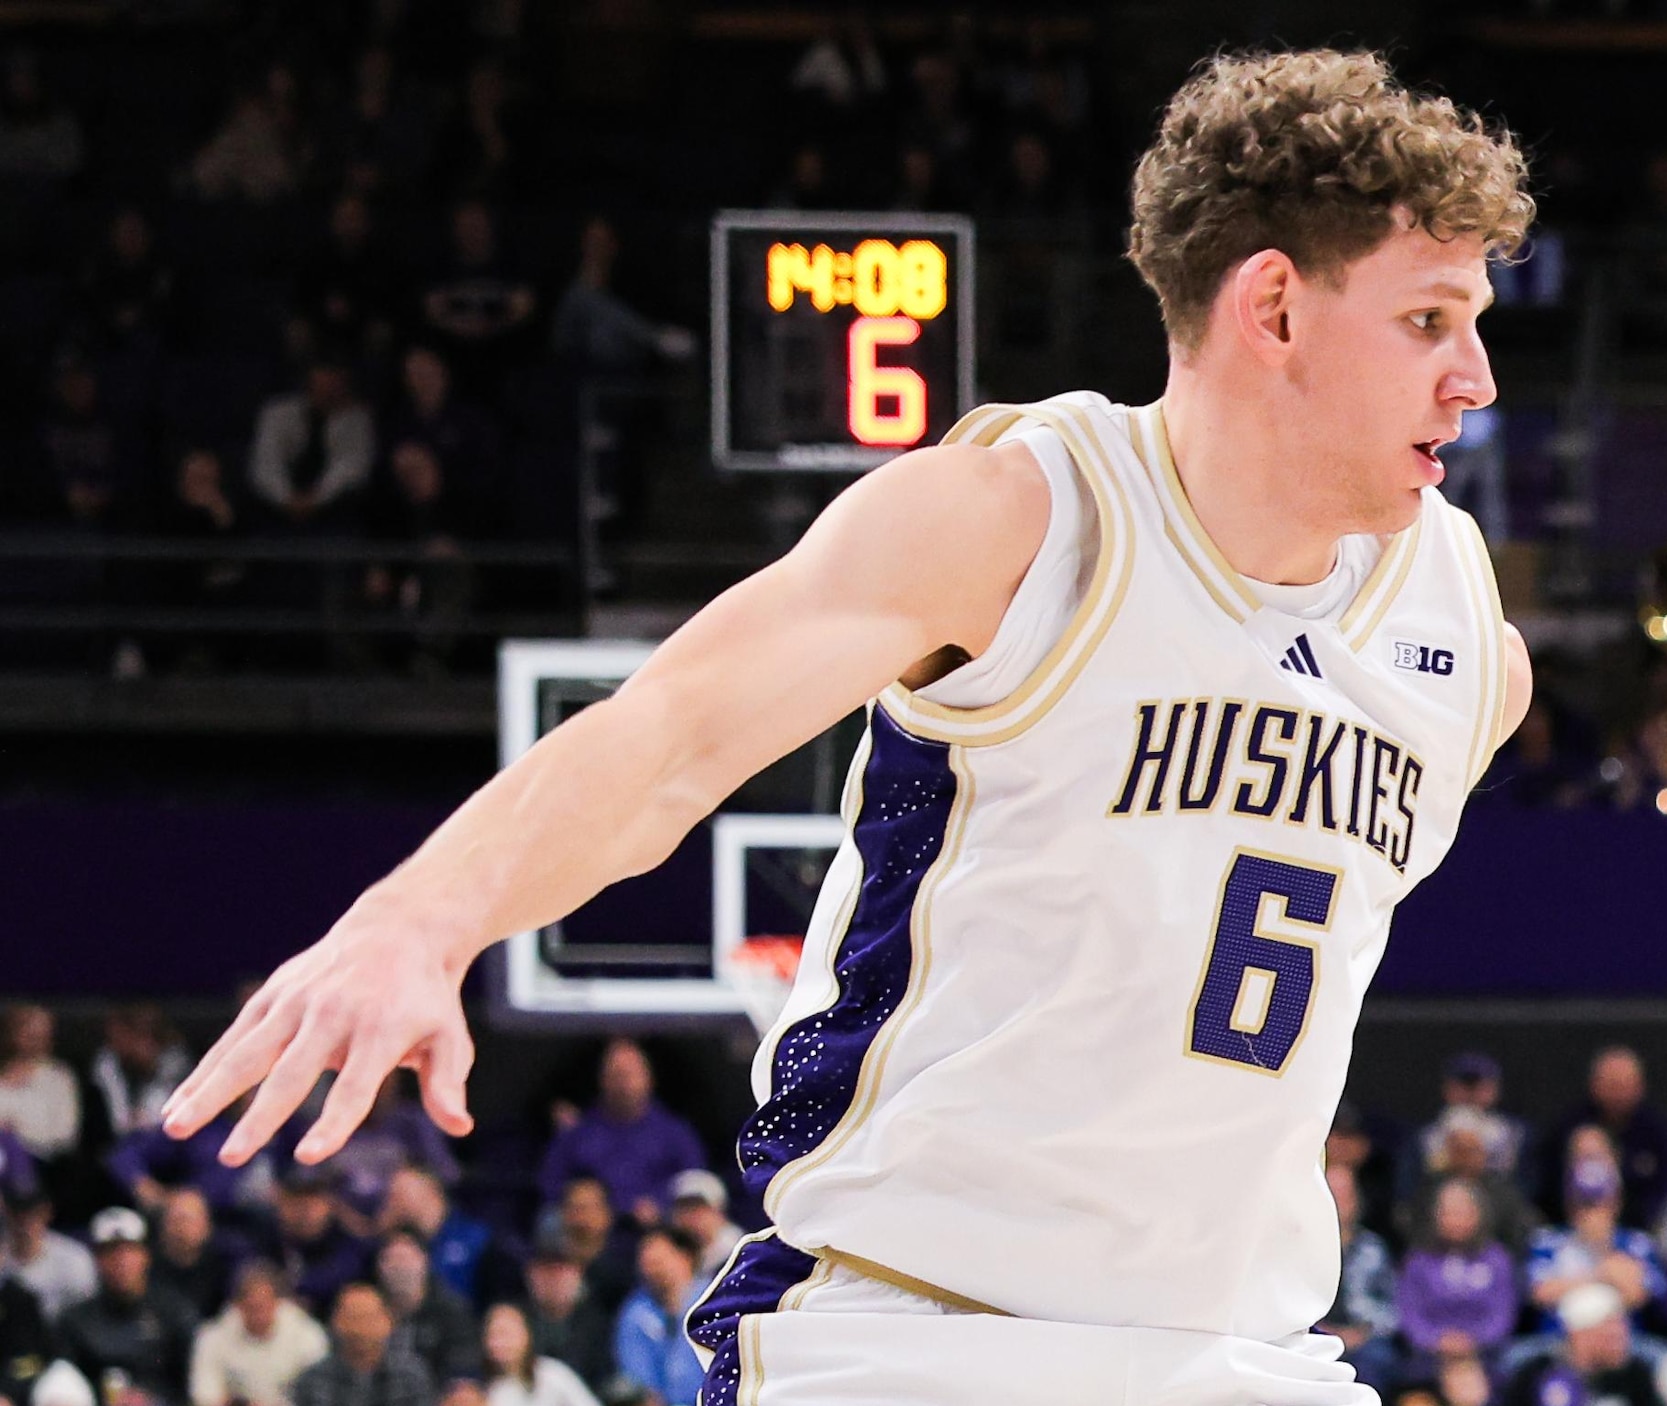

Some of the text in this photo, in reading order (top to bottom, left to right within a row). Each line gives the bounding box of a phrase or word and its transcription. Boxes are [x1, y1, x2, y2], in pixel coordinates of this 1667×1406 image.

[848, 315, 927, 446] 6
[1109, 698, 1425, 873] HUSKIES
[1183, 846, 1344, 1077] 6
